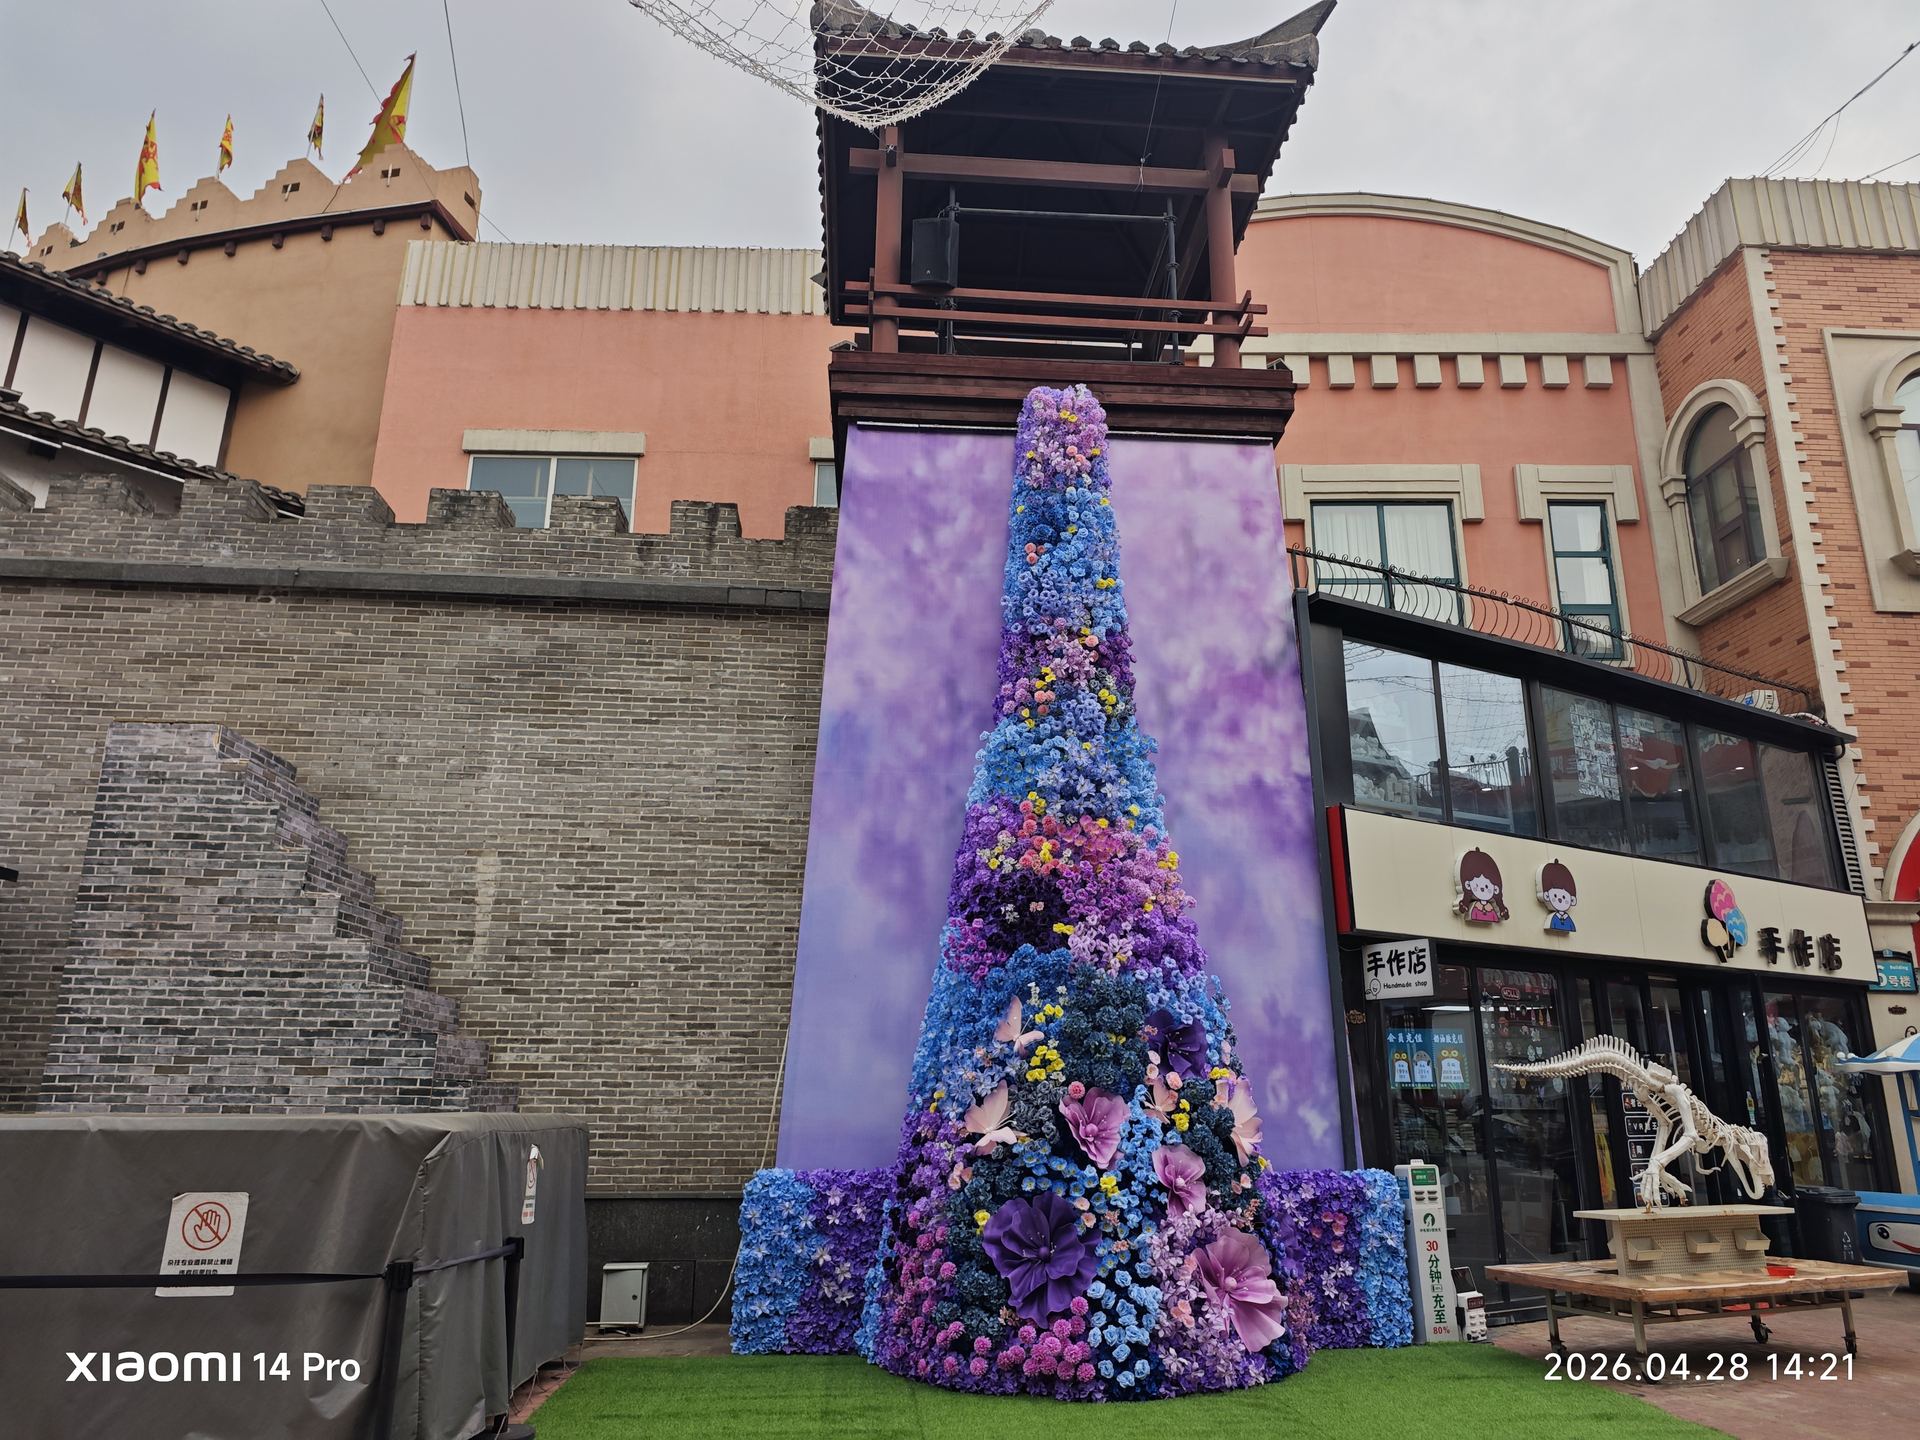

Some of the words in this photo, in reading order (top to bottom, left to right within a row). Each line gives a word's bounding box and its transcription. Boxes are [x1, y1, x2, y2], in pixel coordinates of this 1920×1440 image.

[1757, 927, 1842, 972] 手作店
[1367, 947, 1426, 977] 手作店
[1387, 1032, 1424, 1043] 会员充值
[1426, 1240, 1439, 1252] 30
[1433, 1326, 1451, 1335] 80%
